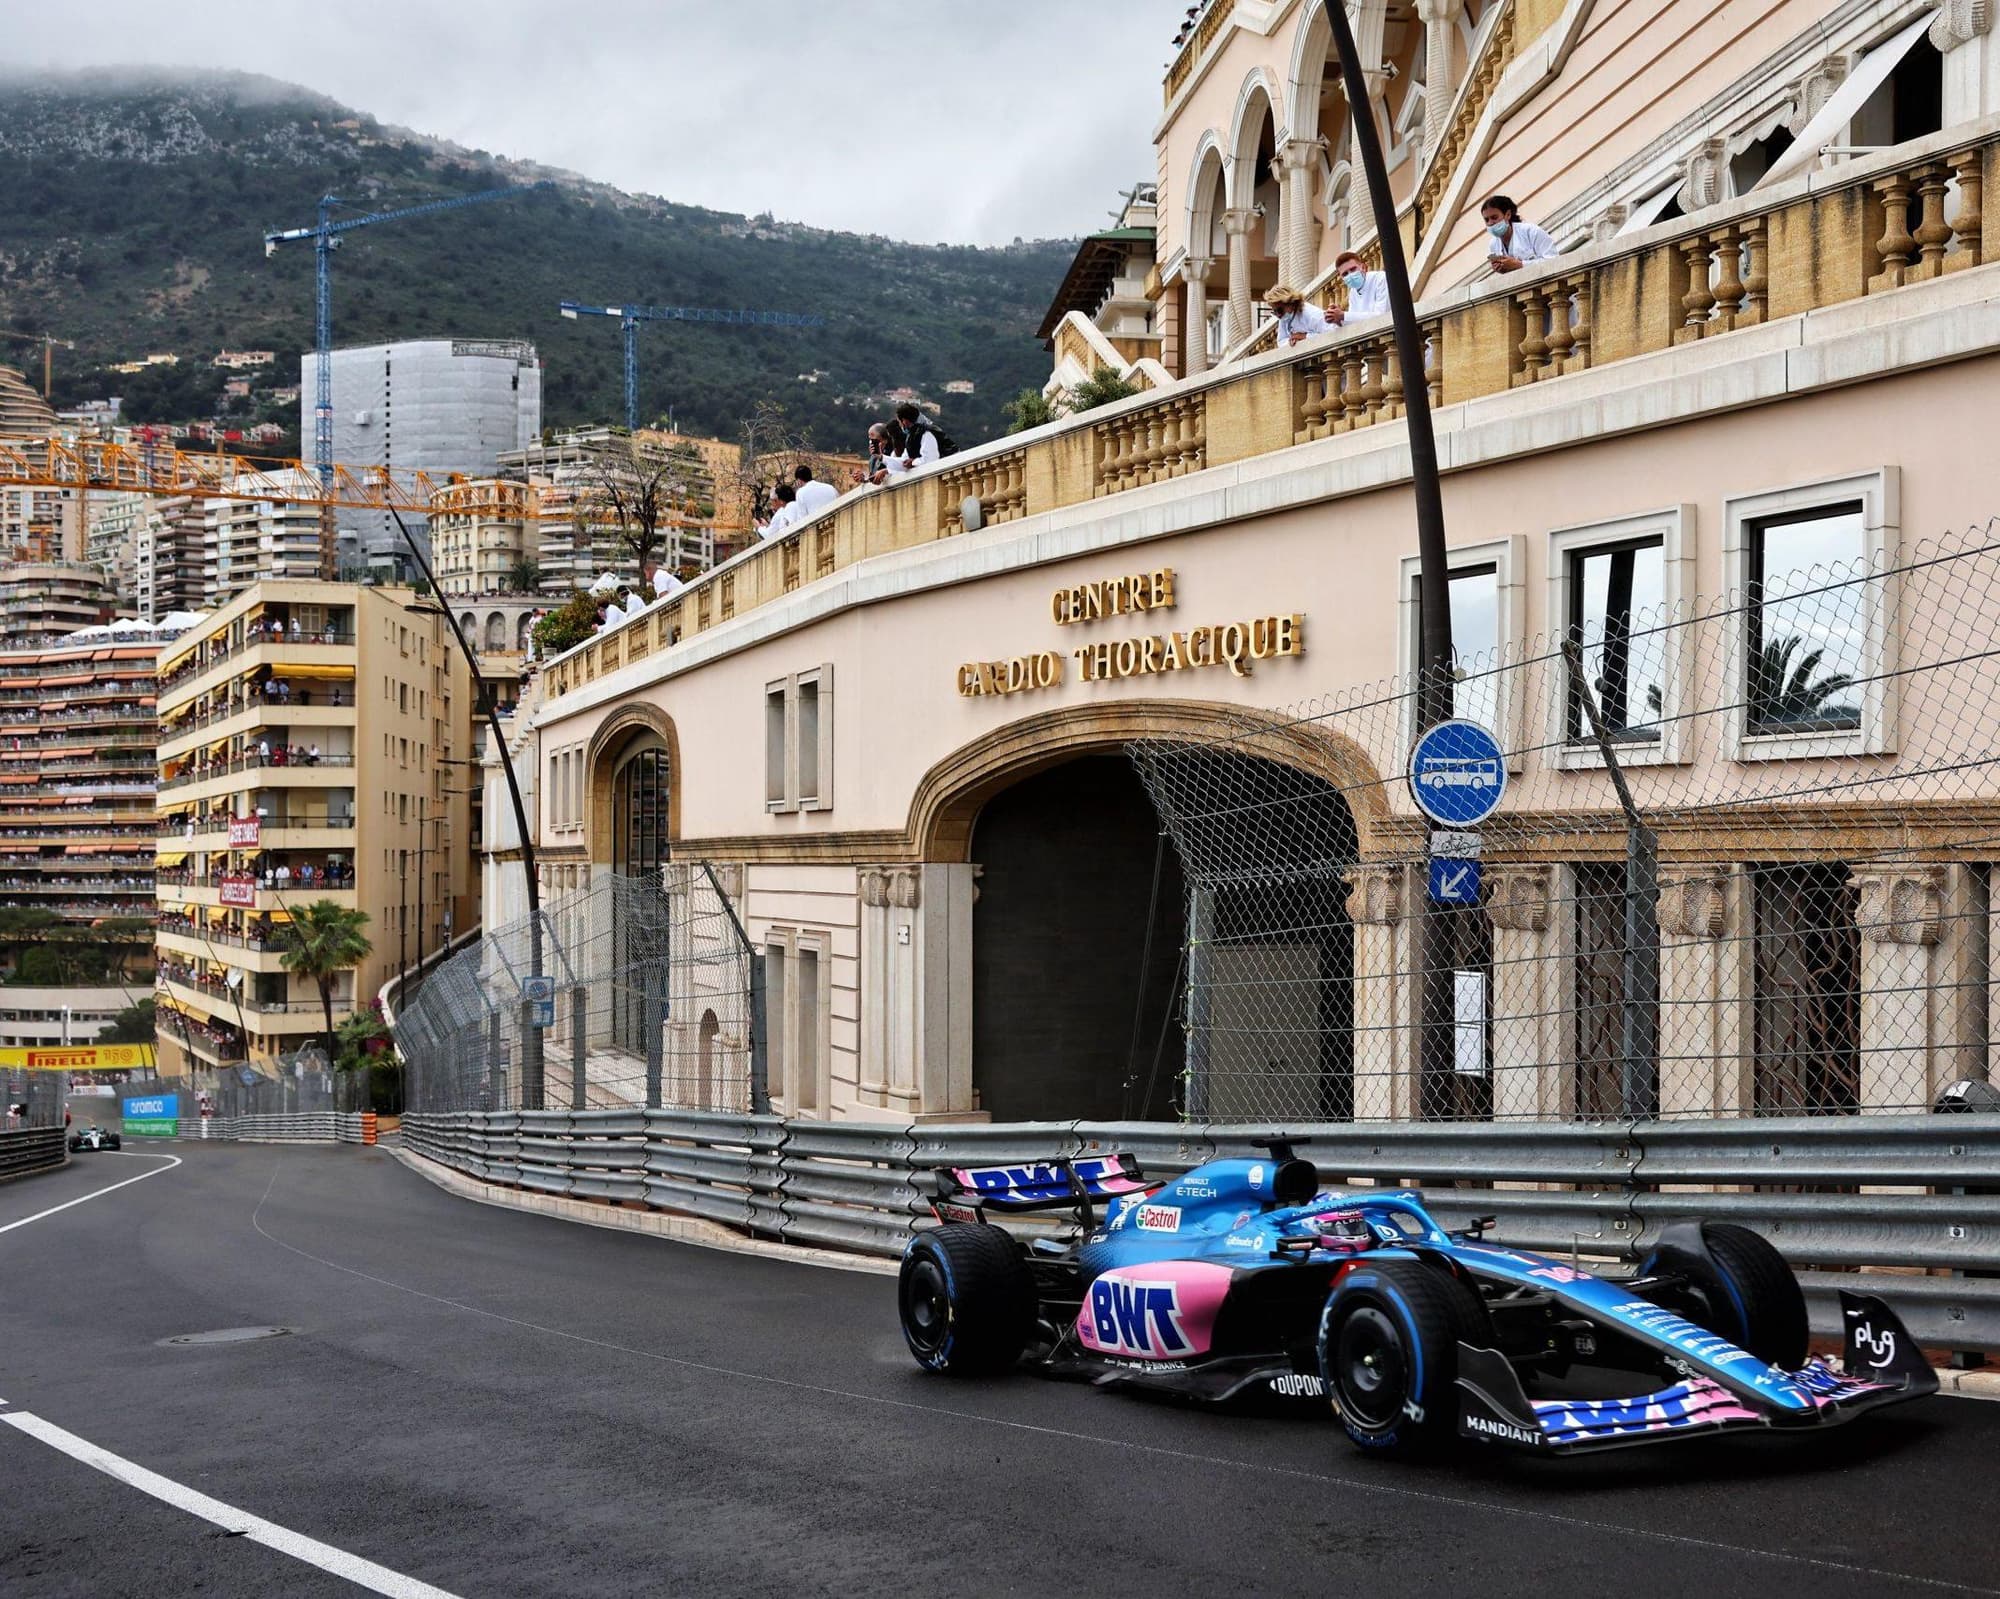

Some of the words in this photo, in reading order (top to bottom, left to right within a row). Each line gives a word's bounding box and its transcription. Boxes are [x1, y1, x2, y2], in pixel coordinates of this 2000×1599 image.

[1051, 568, 1177, 625] CENTRE
[958, 651, 1065, 697] CARDIO
[1075, 614, 1303, 681] THORACIQUE
[28, 1050, 97, 1066] PIRELLI
[1176, 1187, 1217, 1198] E-TECH
[949, 1206, 976, 1224] Castrol
[1144, 1208, 1177, 1229] Castrol
[1092, 1280, 1186, 1351] BWT
[1855, 1321, 1896, 1368] plug
[1152, 1361, 1187, 1370] BINANCE
[1277, 1375, 1323, 1396] DUPON
[1467, 1416, 1542, 1445] MANDIANT
